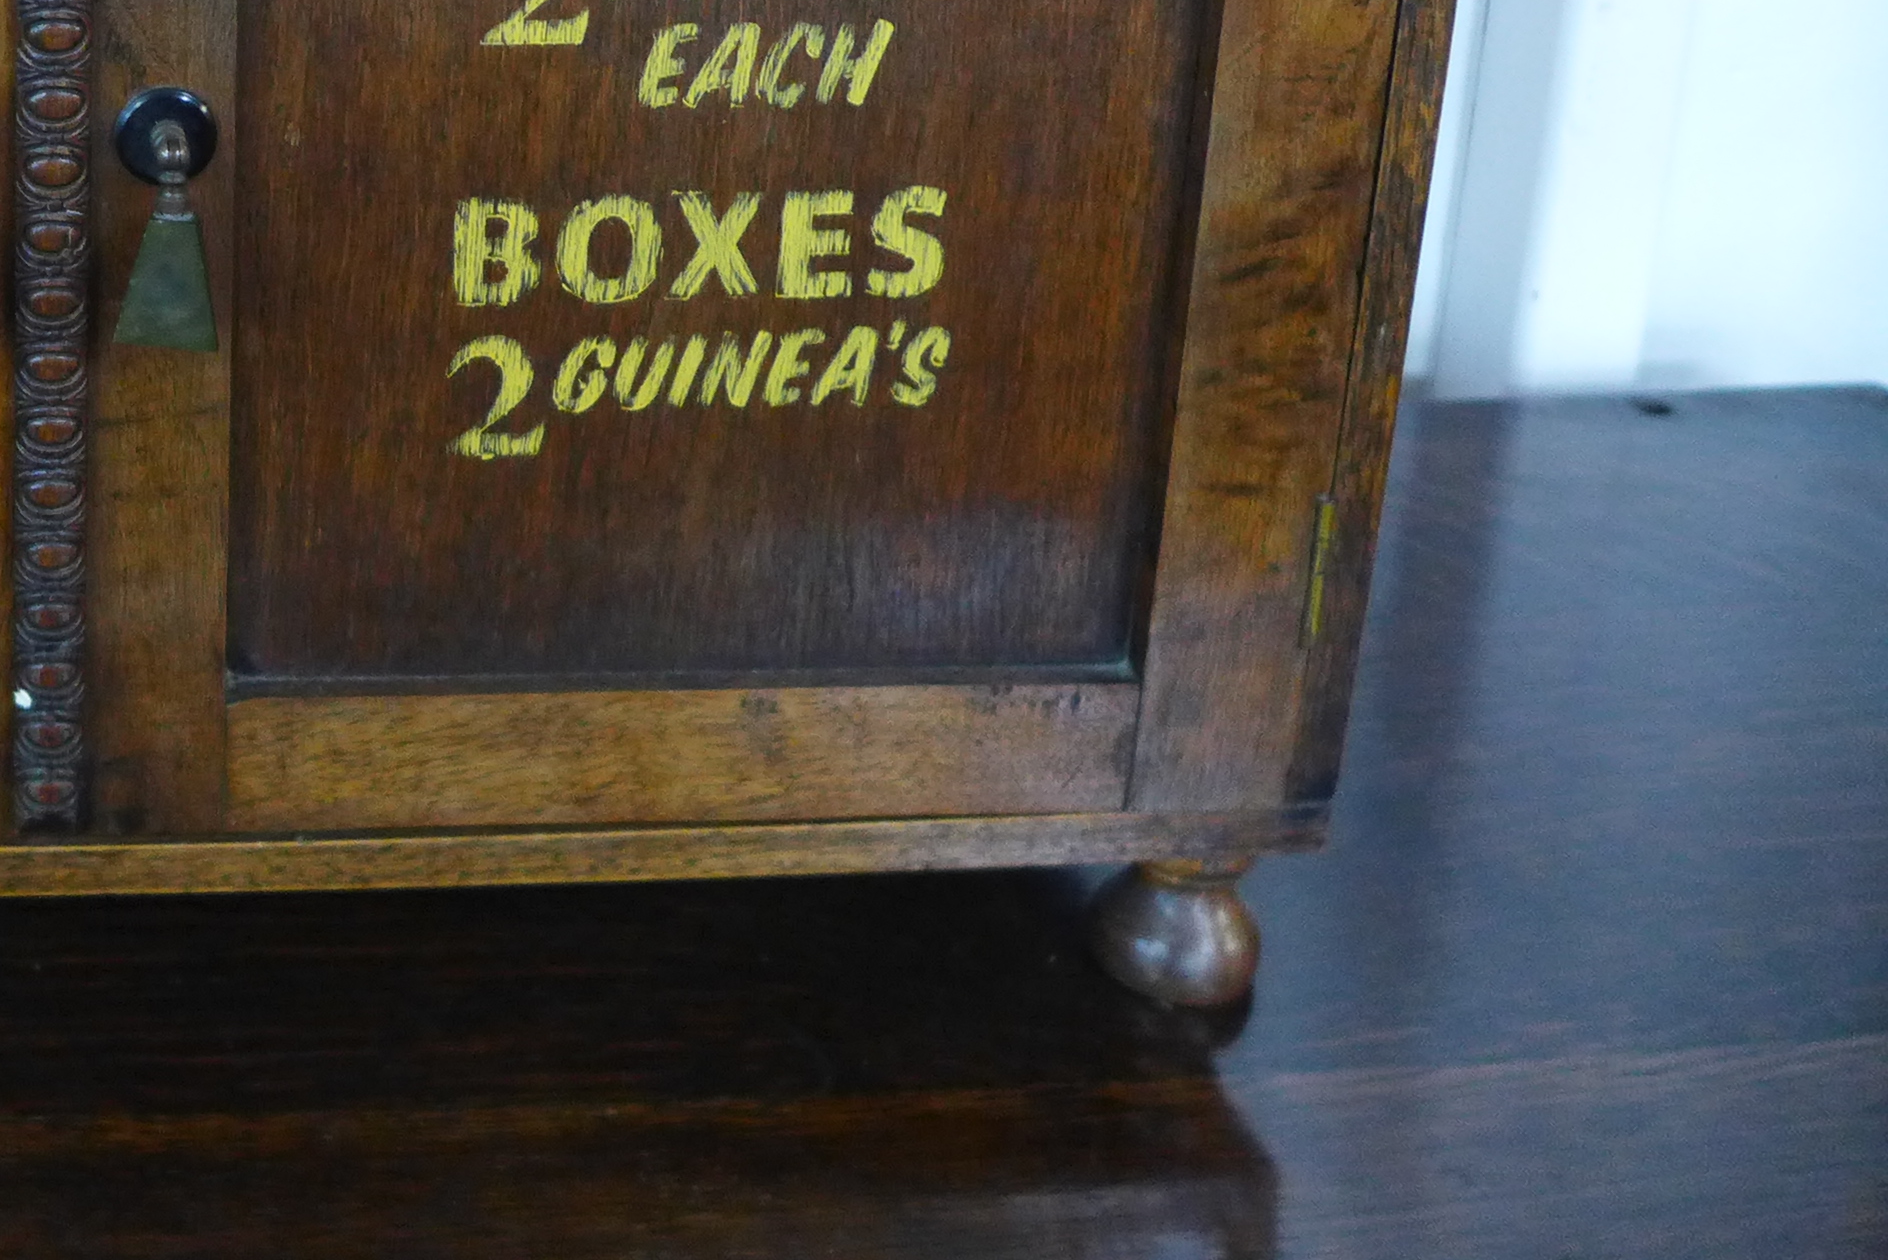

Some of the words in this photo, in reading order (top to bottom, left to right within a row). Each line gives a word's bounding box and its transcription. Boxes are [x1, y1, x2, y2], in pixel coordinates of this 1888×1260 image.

[637, 19, 895, 109] EACH
[453, 186, 948, 307] BOXES
[446, 335, 545, 459] 2
[552, 320, 951, 412] GUINEA'S
